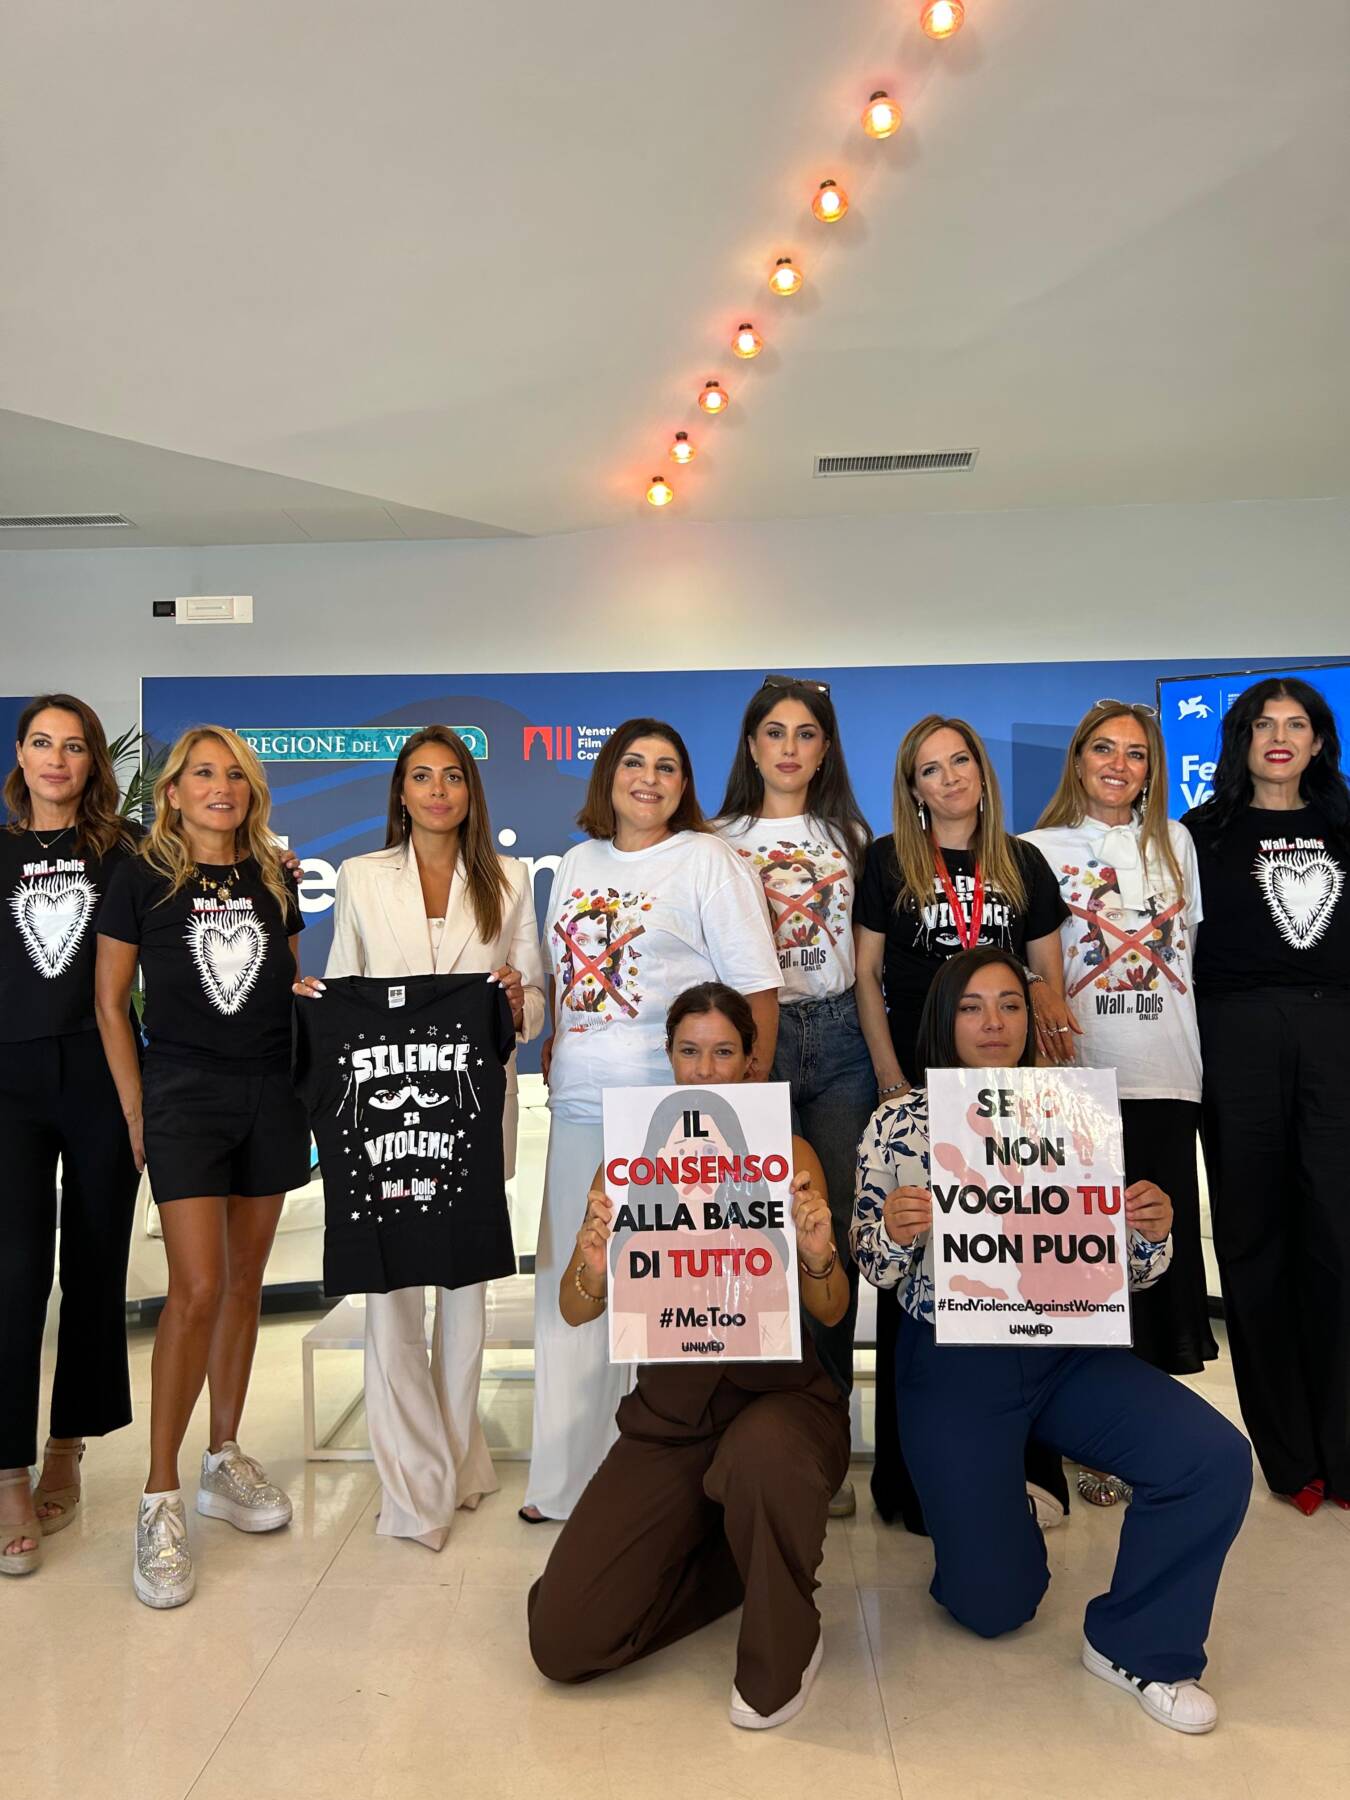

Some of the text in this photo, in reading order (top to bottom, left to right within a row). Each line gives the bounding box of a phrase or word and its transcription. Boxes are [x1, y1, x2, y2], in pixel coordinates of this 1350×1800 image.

[246, 736, 345, 753] REGIONE
[352, 740, 380, 752] DEL
[578, 738, 602, 748] Film
[1260, 838, 1287, 851] Wall
[1296, 838, 1324, 849] Dolls
[23, 860, 48, 876] Wall
[56, 859, 85, 872] Dolls
[193, 898, 218, 911] Wall
[225, 898, 253, 910] Dolls
[921, 902, 1009, 929] VILNCE
[777, 950, 791, 969] all
[801, 947, 826, 966] Dolls
[1096, 994, 1125, 1015] Wall
[1136, 993, 1163, 1014] Dolls
[352, 1043, 470, 1083] SILENCE
[976, 1088, 1017, 1118] SE
[403, 1111, 421, 1126] IS
[682, 1110, 709, 1138] IL
[364, 1130, 455, 1167] VIOLENCE
[985, 1136, 1066, 1167] NON
[606, 1154, 789, 1186] CONSENSO
[382, 1179, 404, 1199] Wall
[411, 1178, 437, 1196] Dolls
[932, 1184, 1121, 1216] VOGLIO TU
[612, 1200, 785, 1233] ALLA BASE
[943, 1233, 1116, 1265] NON PUOI
[629, 1247, 773, 1279] DI TUTTO
[659, 1307, 747, 1328] #MeToo
[937, 1298, 1126, 1315] #EndViolenceAgainstWomen
[1009, 1324, 1053, 1337] UNIMED
[681, 1340, 725, 1353] UNIMED
